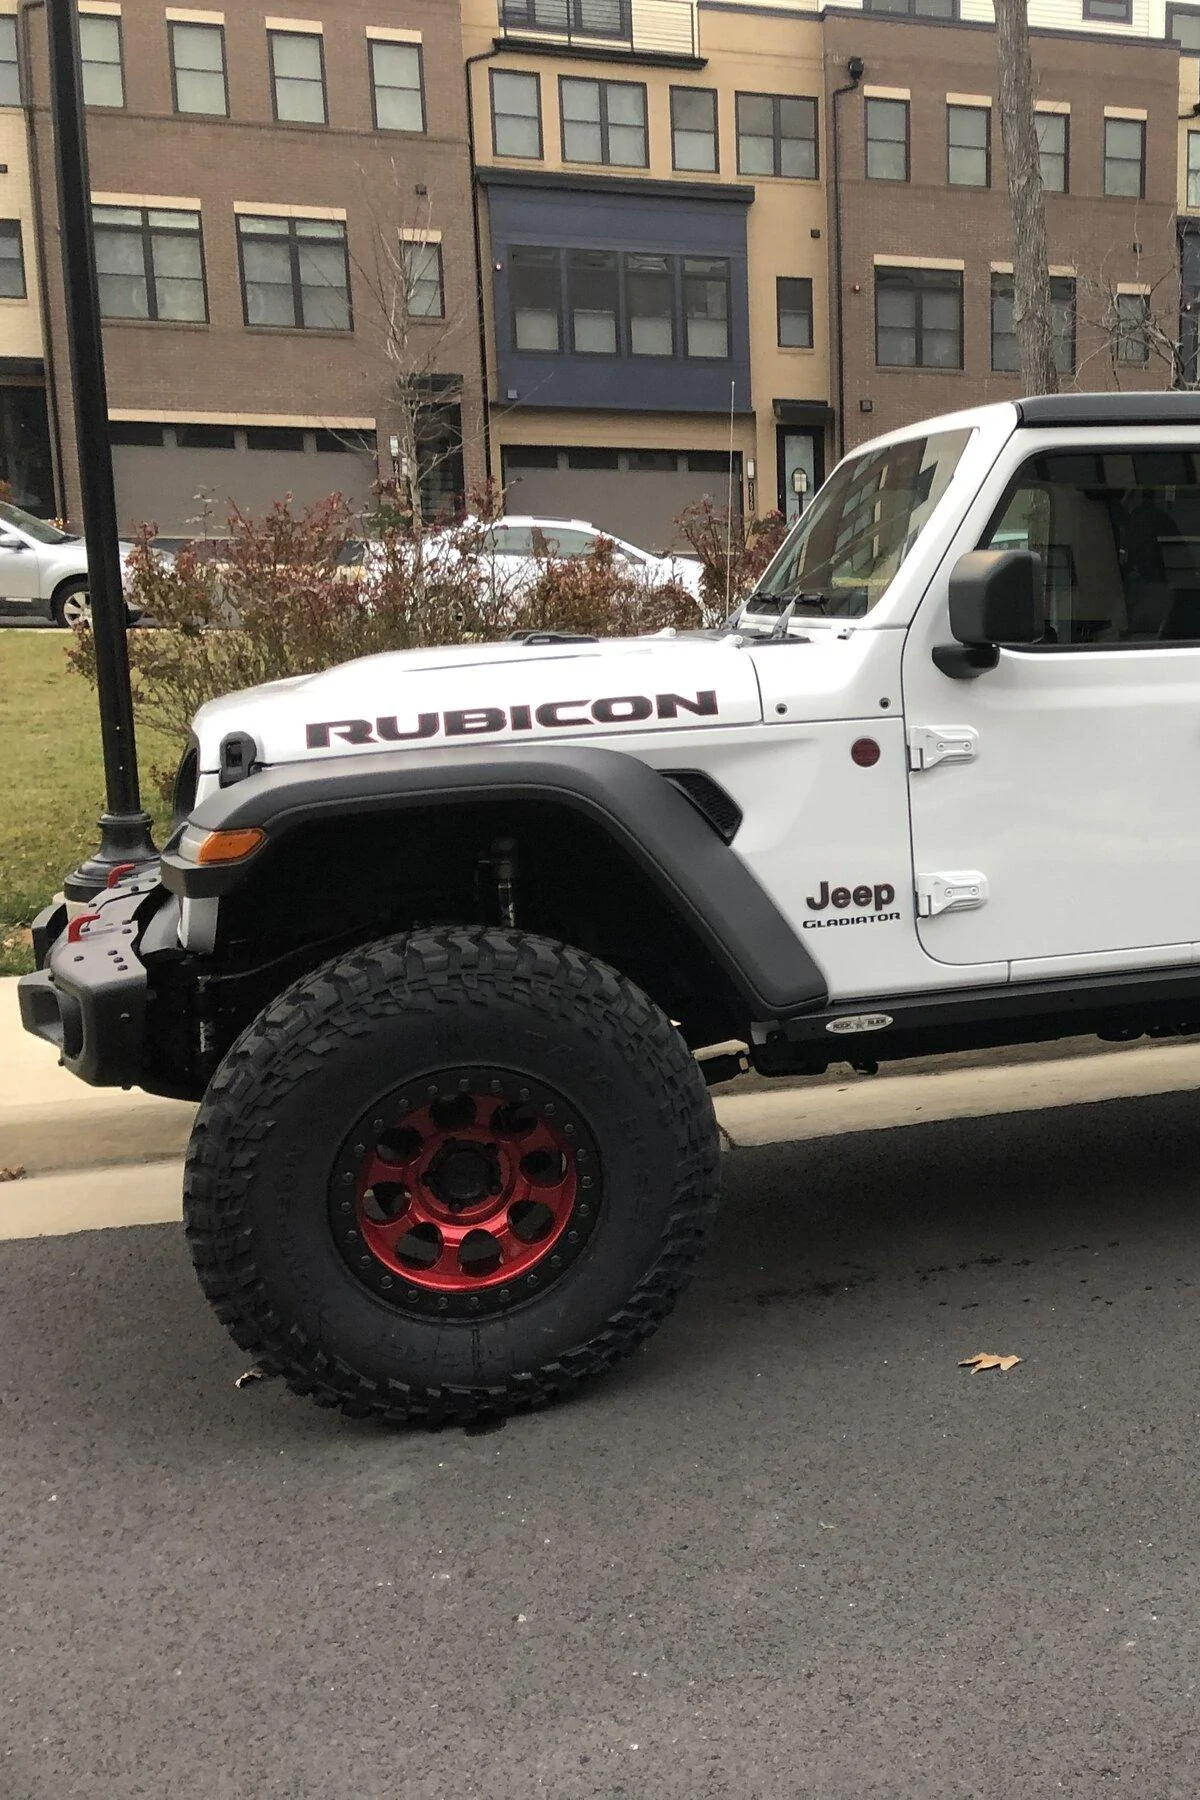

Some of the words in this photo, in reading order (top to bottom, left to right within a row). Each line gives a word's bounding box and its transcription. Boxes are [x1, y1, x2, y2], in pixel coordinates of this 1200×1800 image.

[306, 690, 717, 749] RUBICON
[806, 881, 895, 911] Jeep
[802, 912, 901, 929] GLADIATOR
